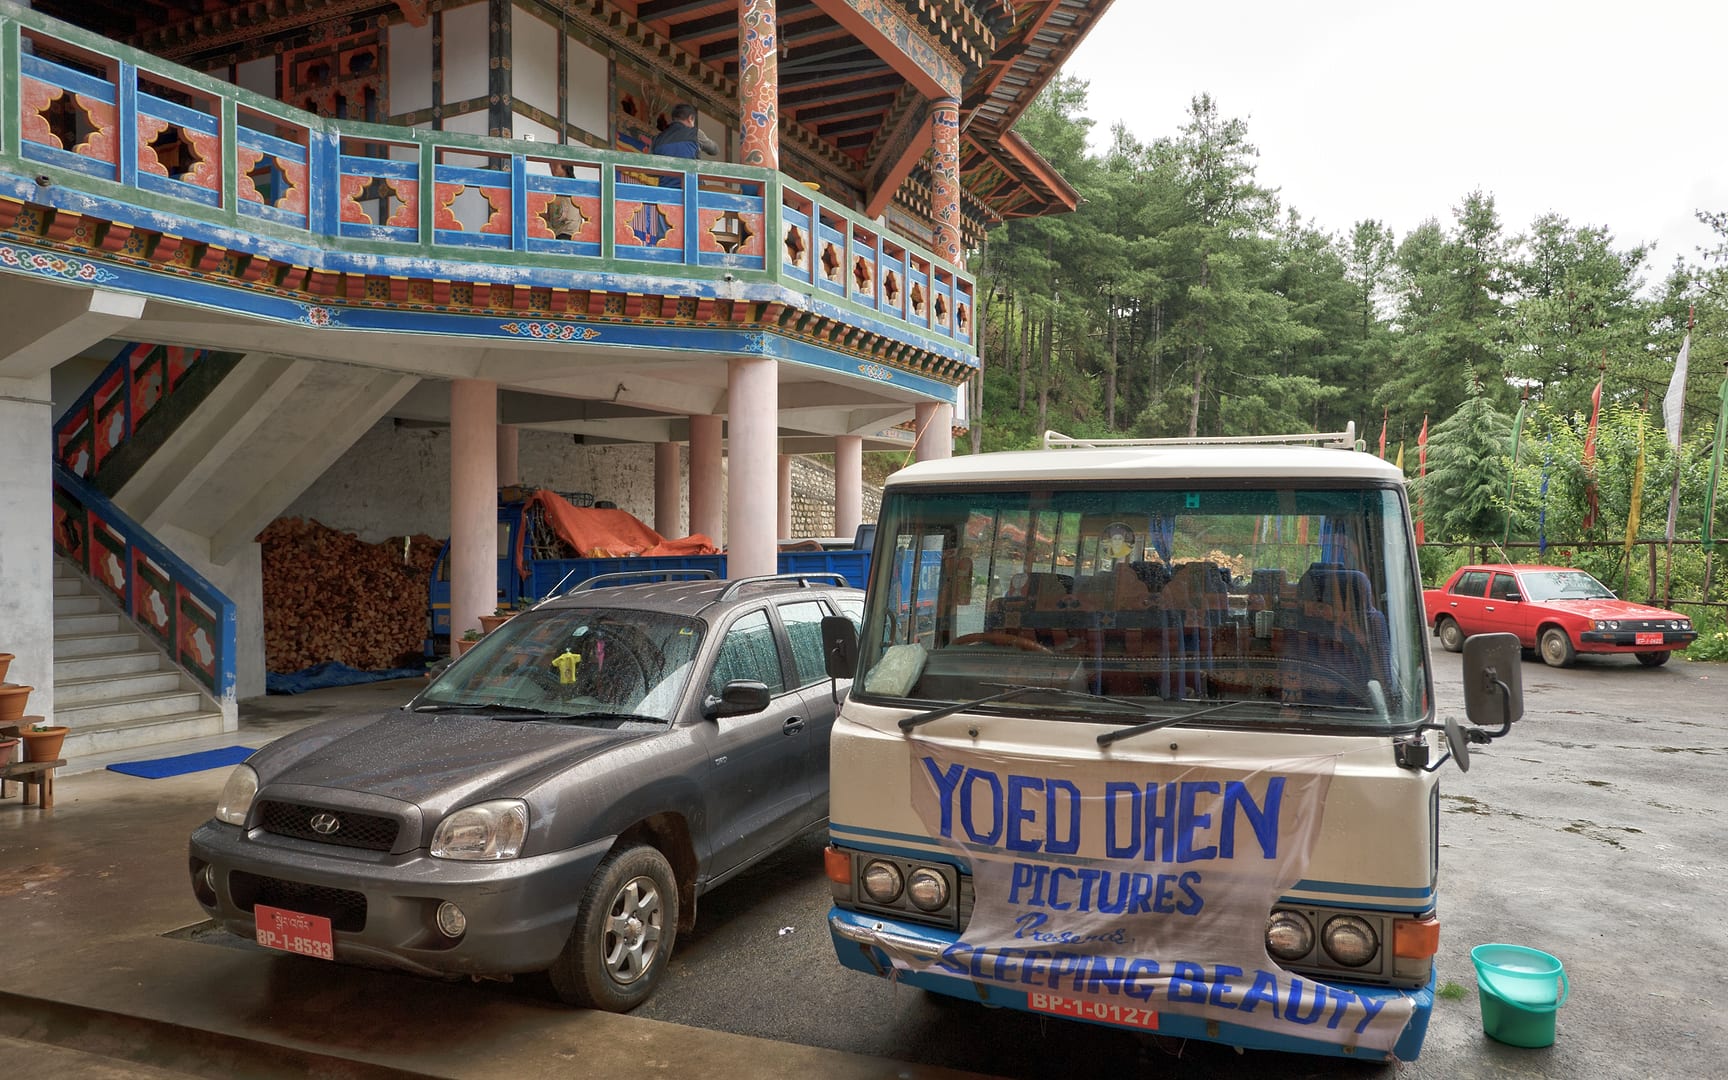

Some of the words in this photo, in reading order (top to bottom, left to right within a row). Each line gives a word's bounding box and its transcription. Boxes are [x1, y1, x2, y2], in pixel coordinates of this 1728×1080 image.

[922, 757, 1081, 855] YOED
[1105, 777, 1287, 863] DHEN
[1008, 863, 1204, 915] PICTURES
[257, 928, 331, 957] BP-1-8533
[938, 942, 1160, 1002] SLEEPING
[1167, 960, 1386, 1034] BEAUTY
[1032, 993, 1153, 1025] BP-1-0127
